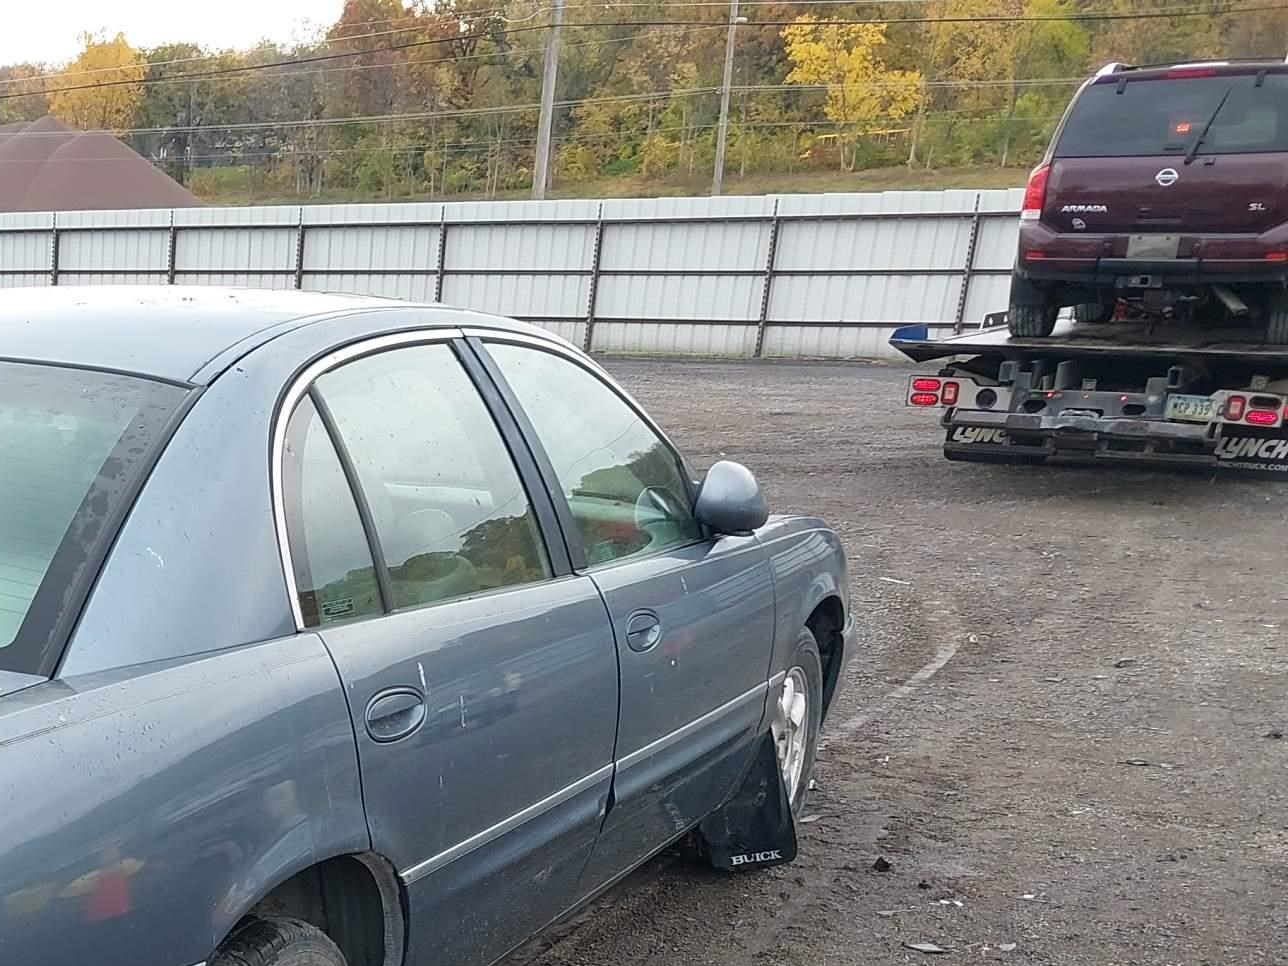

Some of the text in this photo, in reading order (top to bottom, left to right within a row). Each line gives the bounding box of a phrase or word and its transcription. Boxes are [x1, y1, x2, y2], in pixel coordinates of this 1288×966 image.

[1061, 204, 1108, 213] ARMADA
[1247, 202, 1267, 211] SL
[952, 426, 1007, 444] LYNC
[729, 849, 783, 866] BUICK
